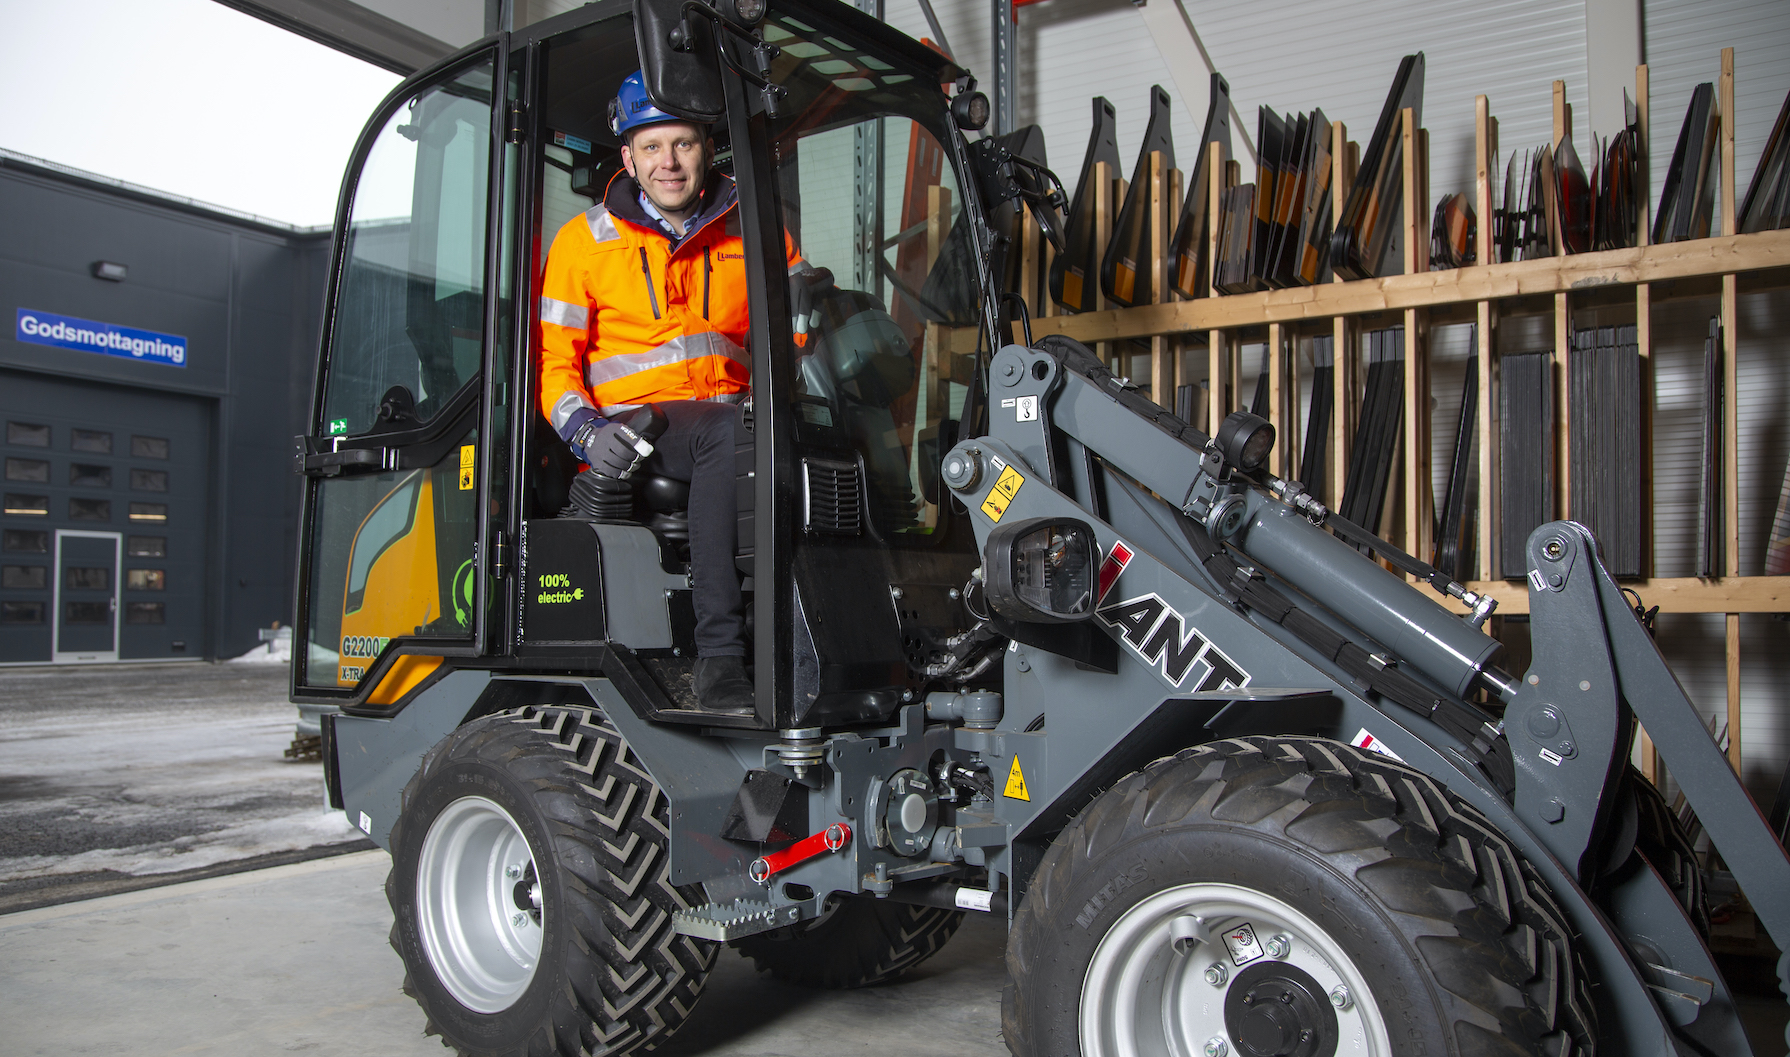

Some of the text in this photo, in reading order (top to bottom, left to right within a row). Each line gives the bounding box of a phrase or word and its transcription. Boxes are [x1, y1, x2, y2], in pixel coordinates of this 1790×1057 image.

[20, 315, 184, 364] Godsmottagning
[539, 574, 570, 588] 100%
[538, 590, 572, 604] electric
[1012, 768, 1021, 778] 4m
[1075, 863, 1149, 930] MITAS
